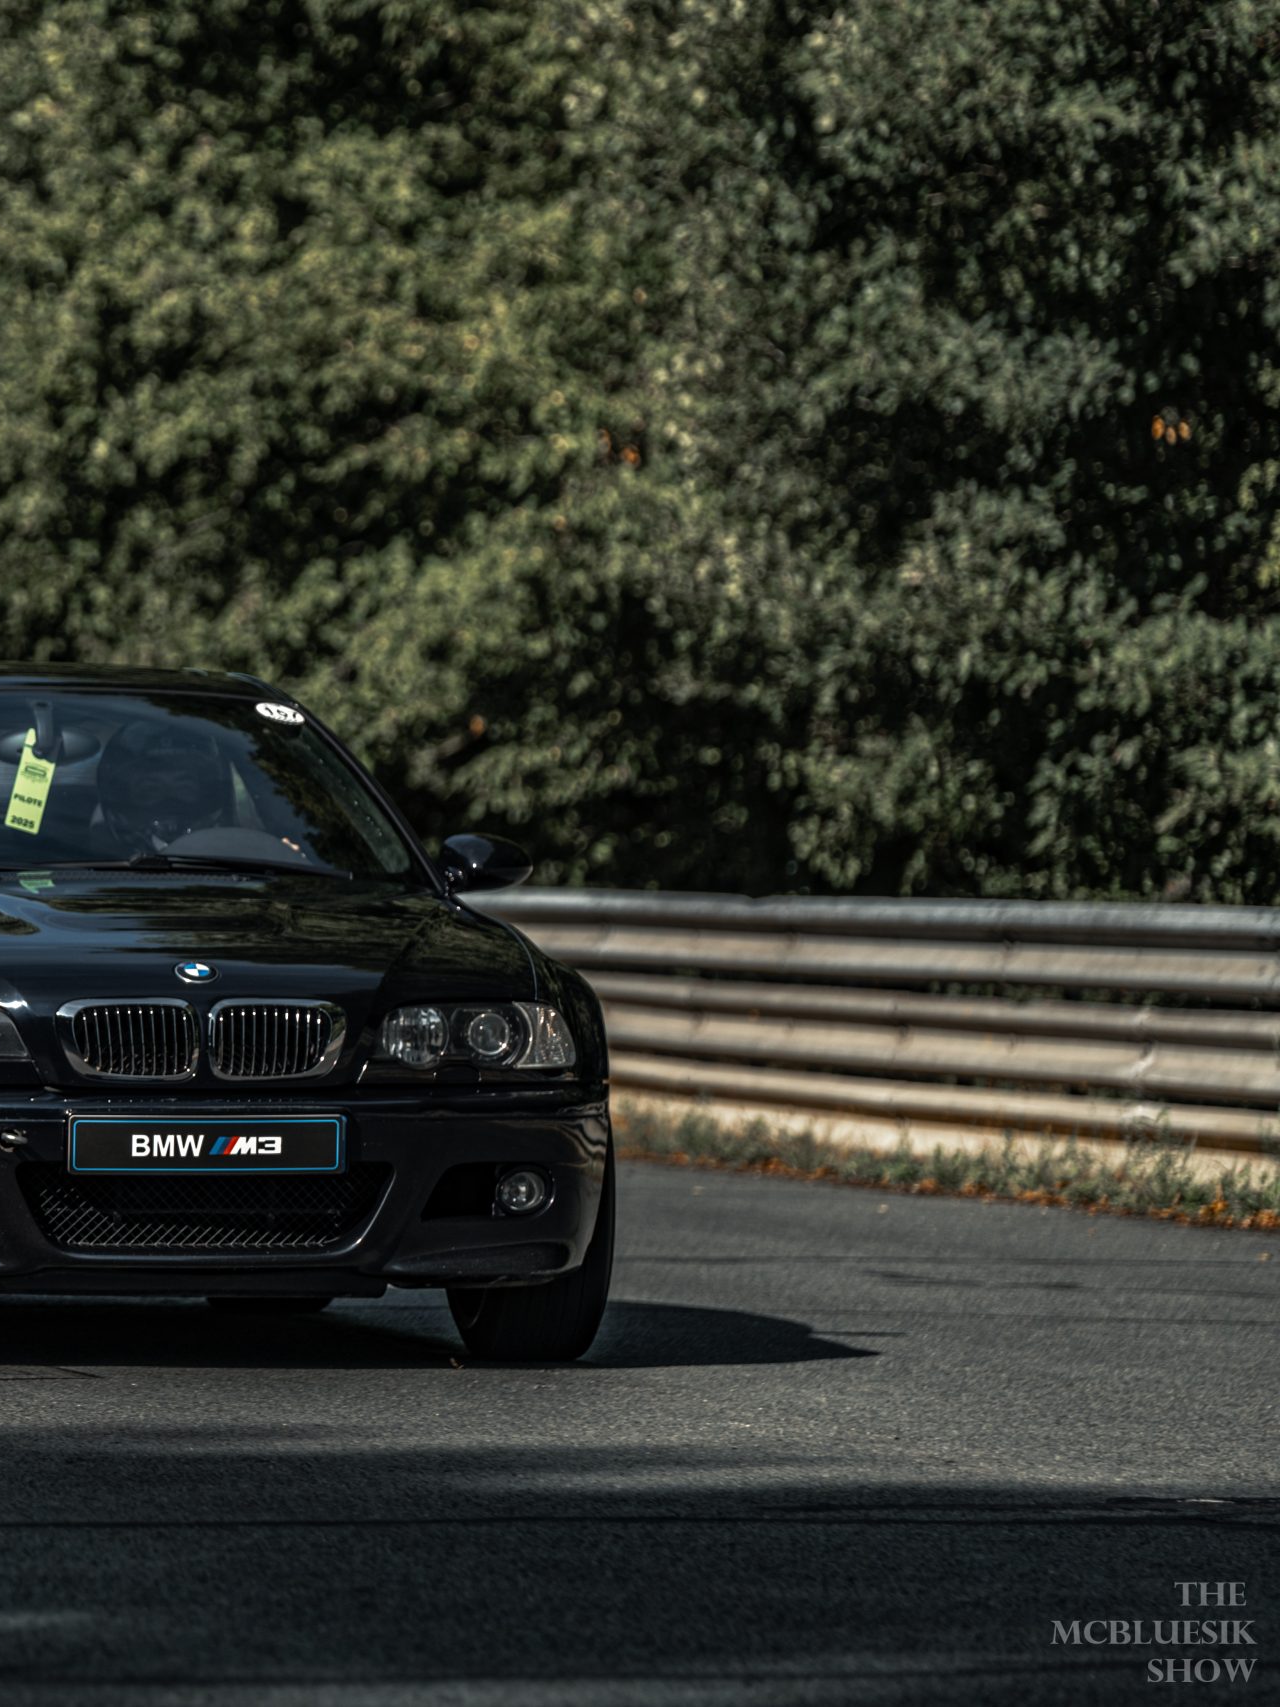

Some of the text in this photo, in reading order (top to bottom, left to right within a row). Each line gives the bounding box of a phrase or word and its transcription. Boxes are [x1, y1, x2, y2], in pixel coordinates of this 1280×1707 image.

[13, 793, 43, 807] PILOTE
[11, 815, 35, 829] 2025
[131, 1134, 282, 1157] BMW M3
